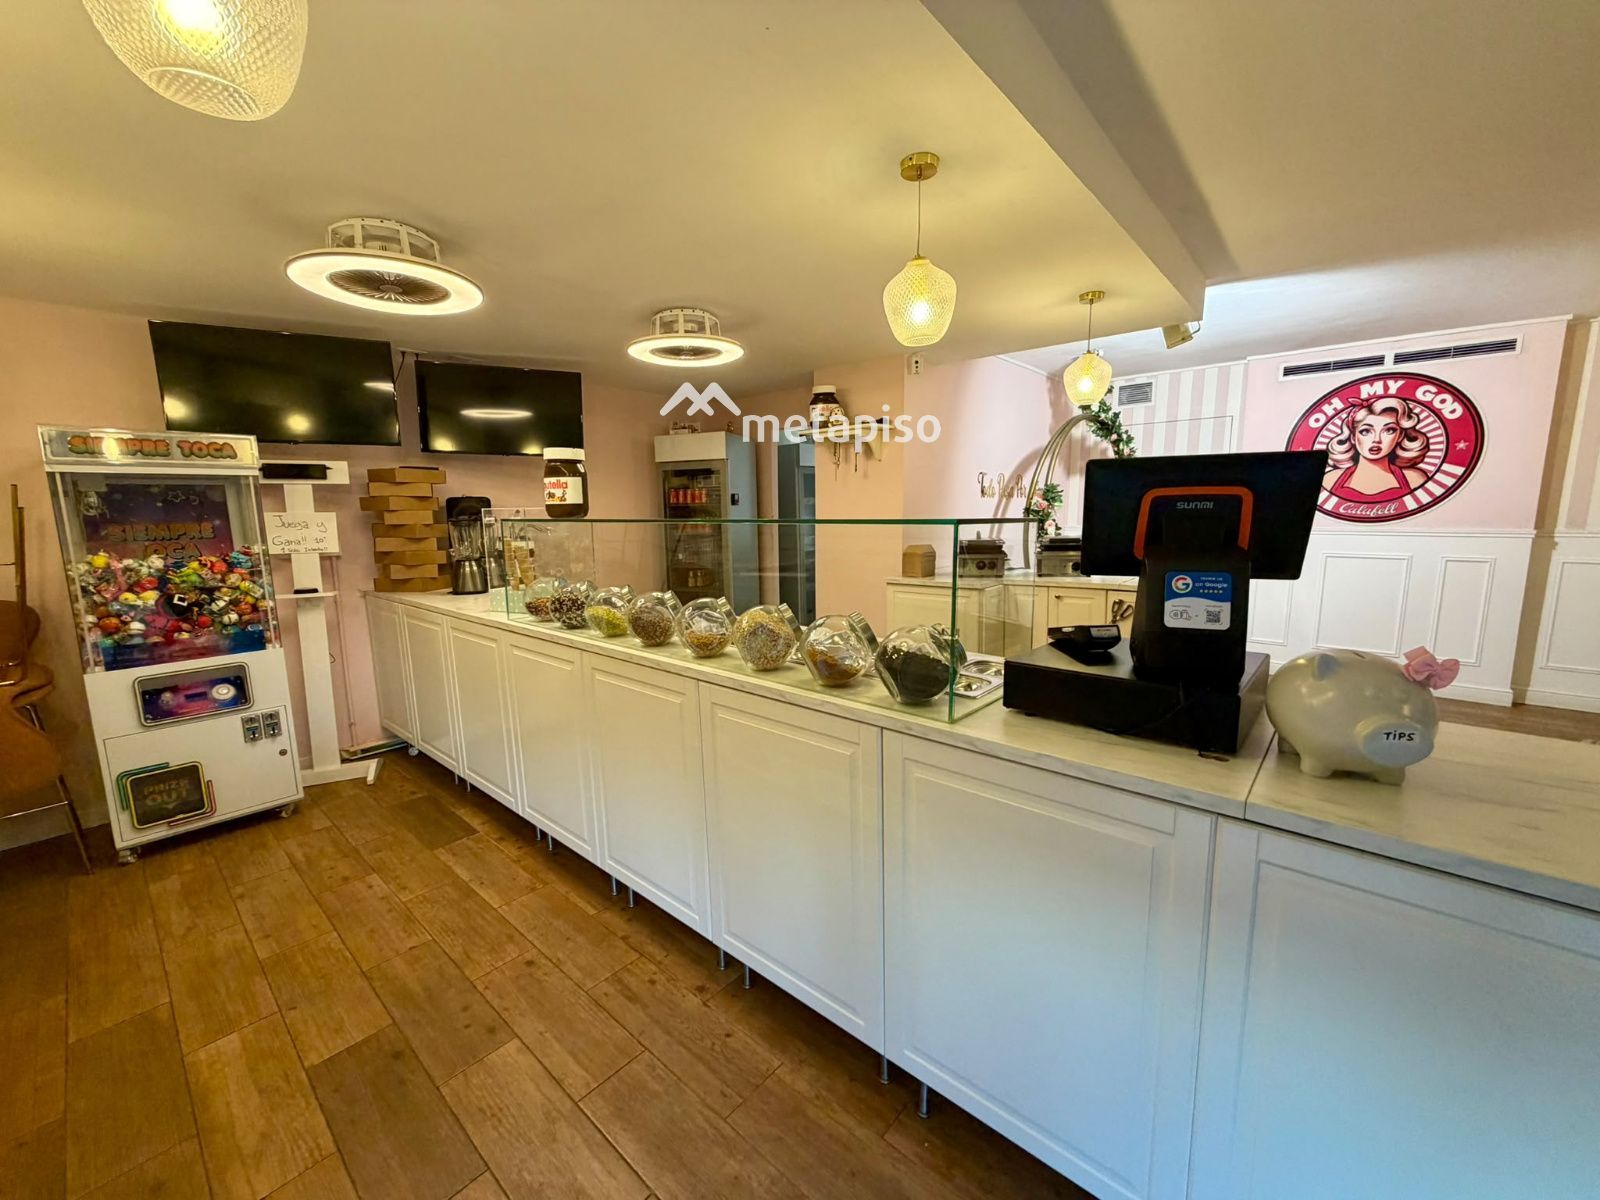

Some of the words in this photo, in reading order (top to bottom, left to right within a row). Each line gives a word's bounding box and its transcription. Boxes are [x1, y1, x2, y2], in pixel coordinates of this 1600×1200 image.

[1308, 397, 1345, 428] OH
[1360, 380, 1406, 399] MY
[1415, 385, 1463, 420] GOD
[176, 439, 238, 460] TOCA
[544, 479, 568, 490] utella
[1339, 503, 1398, 516] Calafell
[272, 514, 309, 530] Juega
[108, 522, 216, 541] SIEMPRE
[1204, 581, 1228, 589] Google
